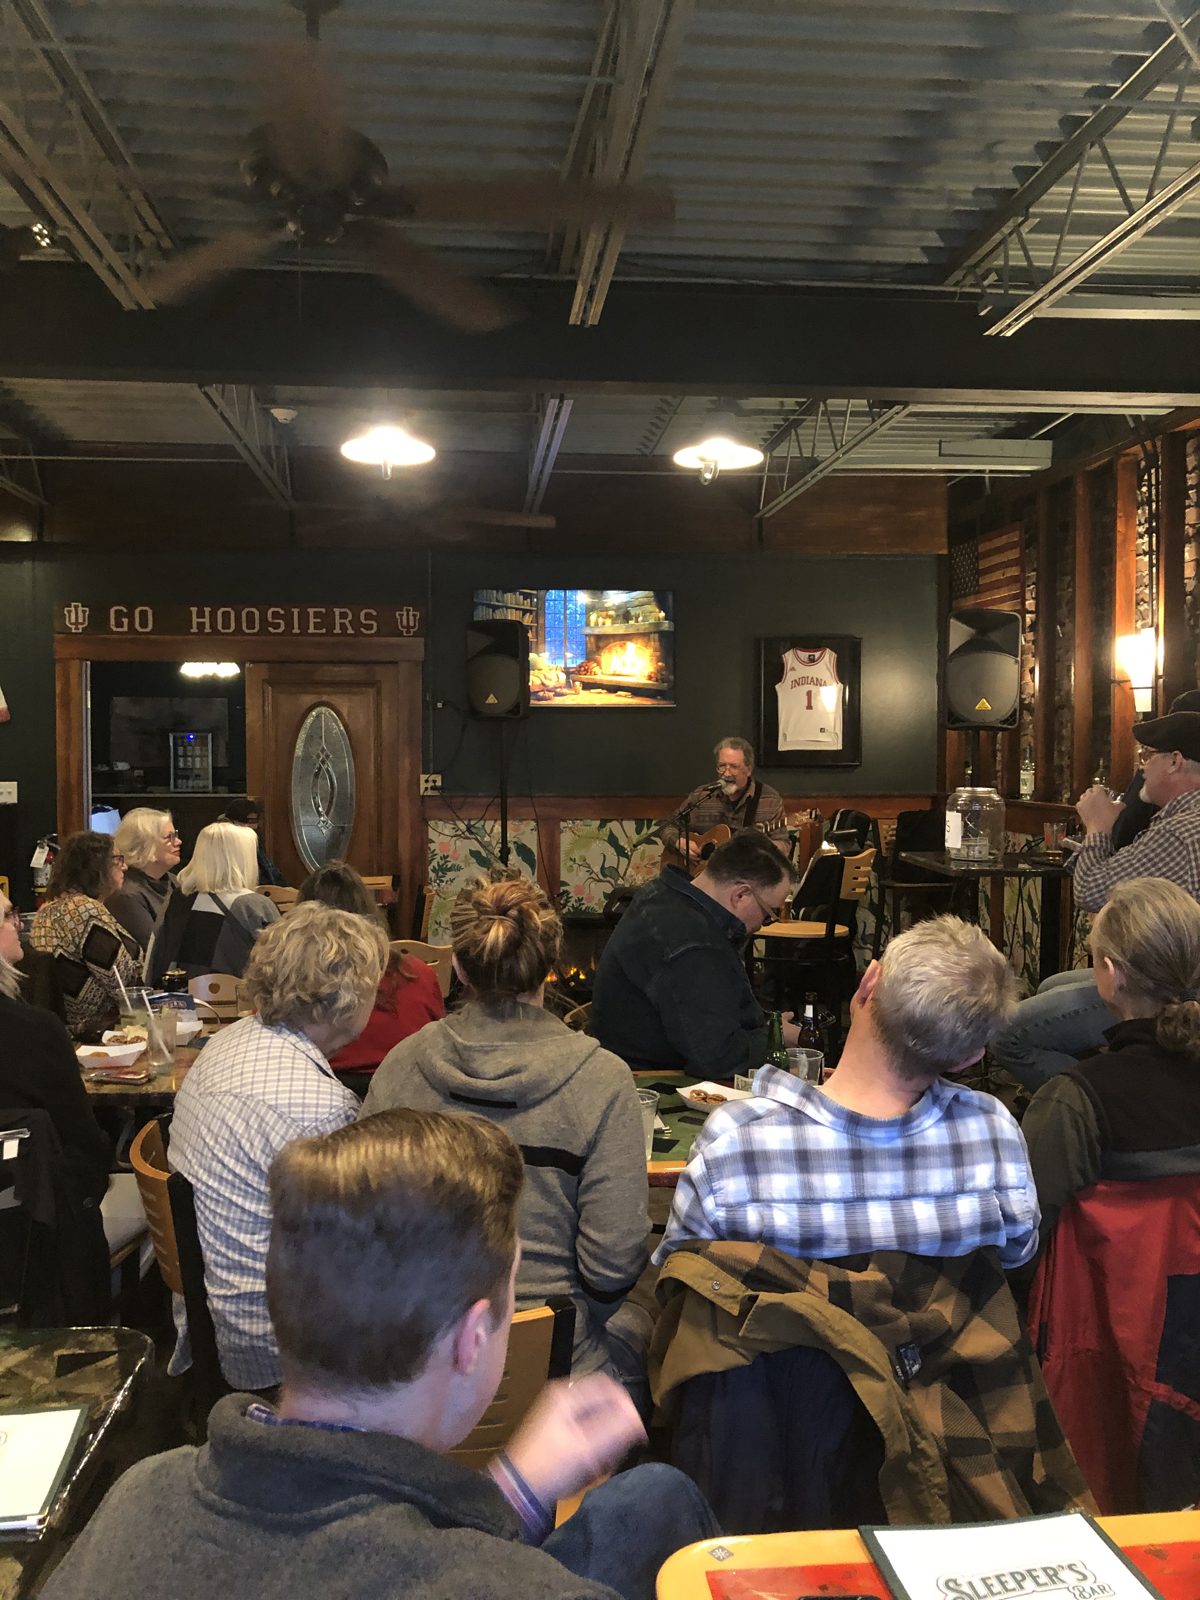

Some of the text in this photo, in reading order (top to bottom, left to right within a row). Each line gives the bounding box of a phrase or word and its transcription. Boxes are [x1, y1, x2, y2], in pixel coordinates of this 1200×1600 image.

[109, 606, 153, 632] GO
[190, 606, 378, 634] HOOSIERS
[790, 676, 827, 689] INDIANA
[805, 690, 813, 710] 1
[945, 1563, 1088, 1600] SLEEPER'S
[1072, 1584, 1109, 1599] BAR
